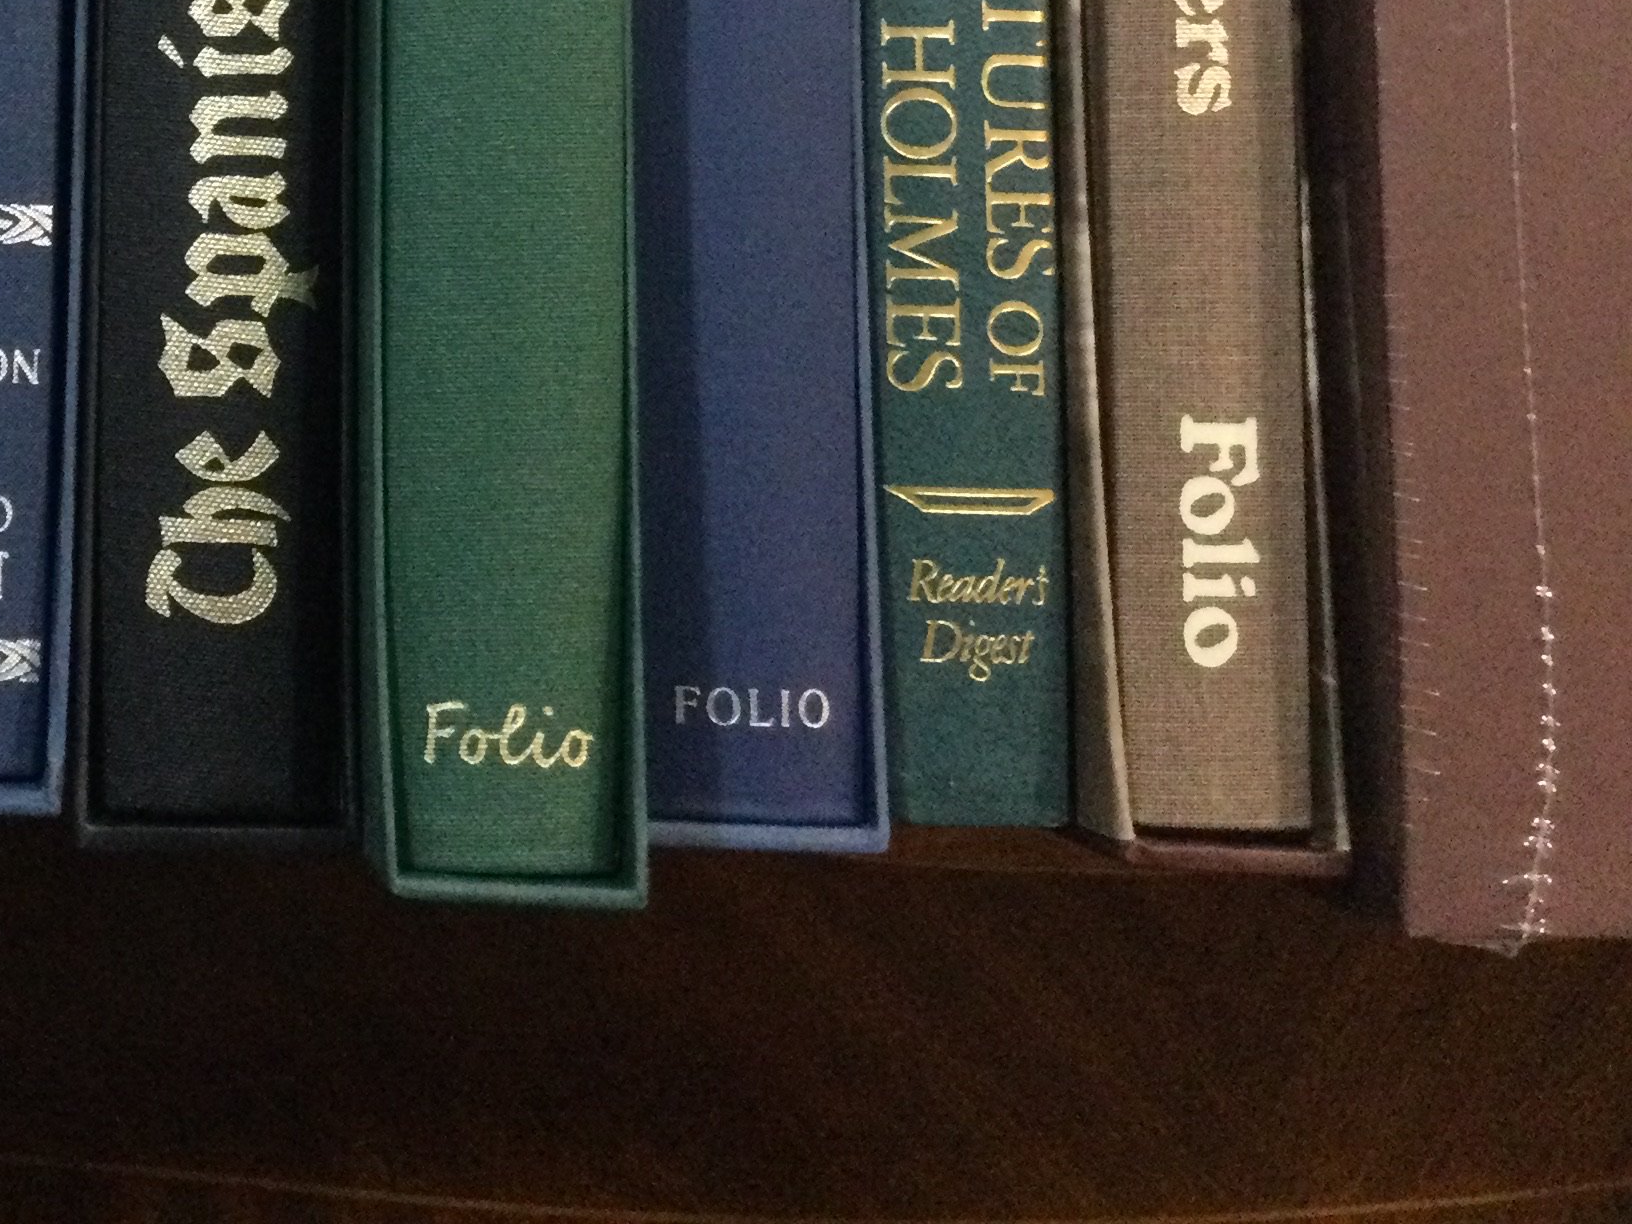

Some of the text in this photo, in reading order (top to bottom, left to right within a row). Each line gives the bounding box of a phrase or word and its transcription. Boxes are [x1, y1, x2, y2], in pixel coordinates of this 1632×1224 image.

[880, 18, 964, 393] HOLMES
[986, 300, 1046, 396] OF
[144, 429, 292, 625] The
[1179, 413, 1261, 669] Folio
[920, 618, 1036, 682] Digest
[423, 700, 595, 769] Folio
[674, 685, 831, 729] FOLIO
